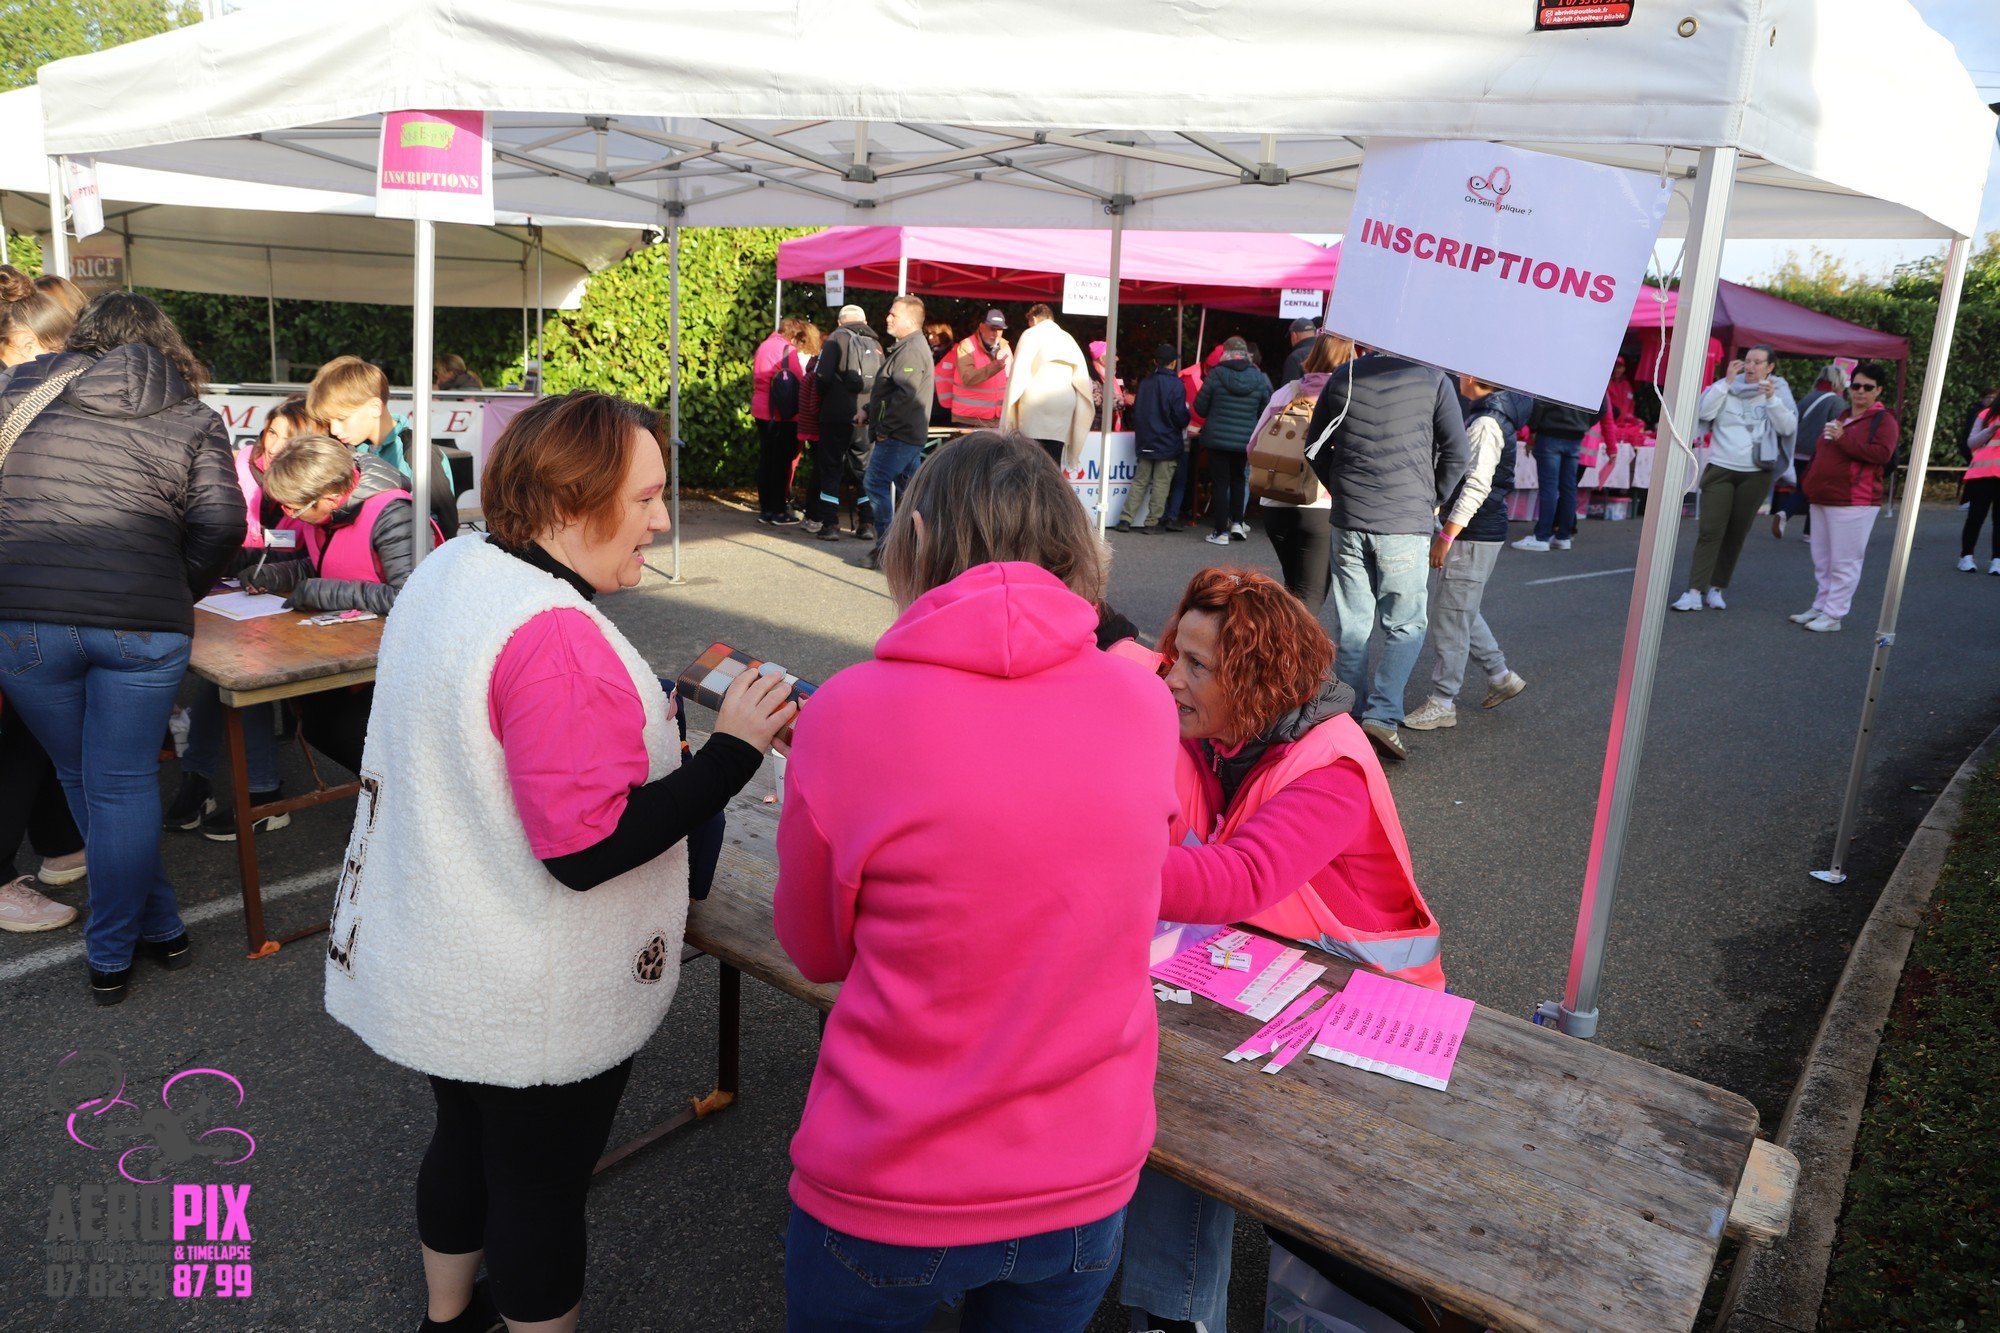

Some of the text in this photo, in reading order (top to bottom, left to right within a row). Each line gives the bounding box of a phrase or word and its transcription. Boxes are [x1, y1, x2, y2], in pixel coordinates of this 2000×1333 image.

[383, 170, 479, 189] INSCRIPTIONS
[1464, 195, 1477, 203] On
[1360, 218, 1616, 304] INSCRIPTIONS
[1330, 1015, 1341, 1026] Rose
[1343, 1020, 1355, 1031] Rose
[1357, 1025, 1368, 1036] Rose
[1371, 1029, 1382, 1040] Rose
[1385, 1033, 1396, 1044] Rose
[1400, 1037, 1411, 1048] Rose
[1414, 1041, 1425, 1052] Rose
[1428, 1044, 1440, 1055] Rose
[1443, 1047, 1454, 1058] Rose
